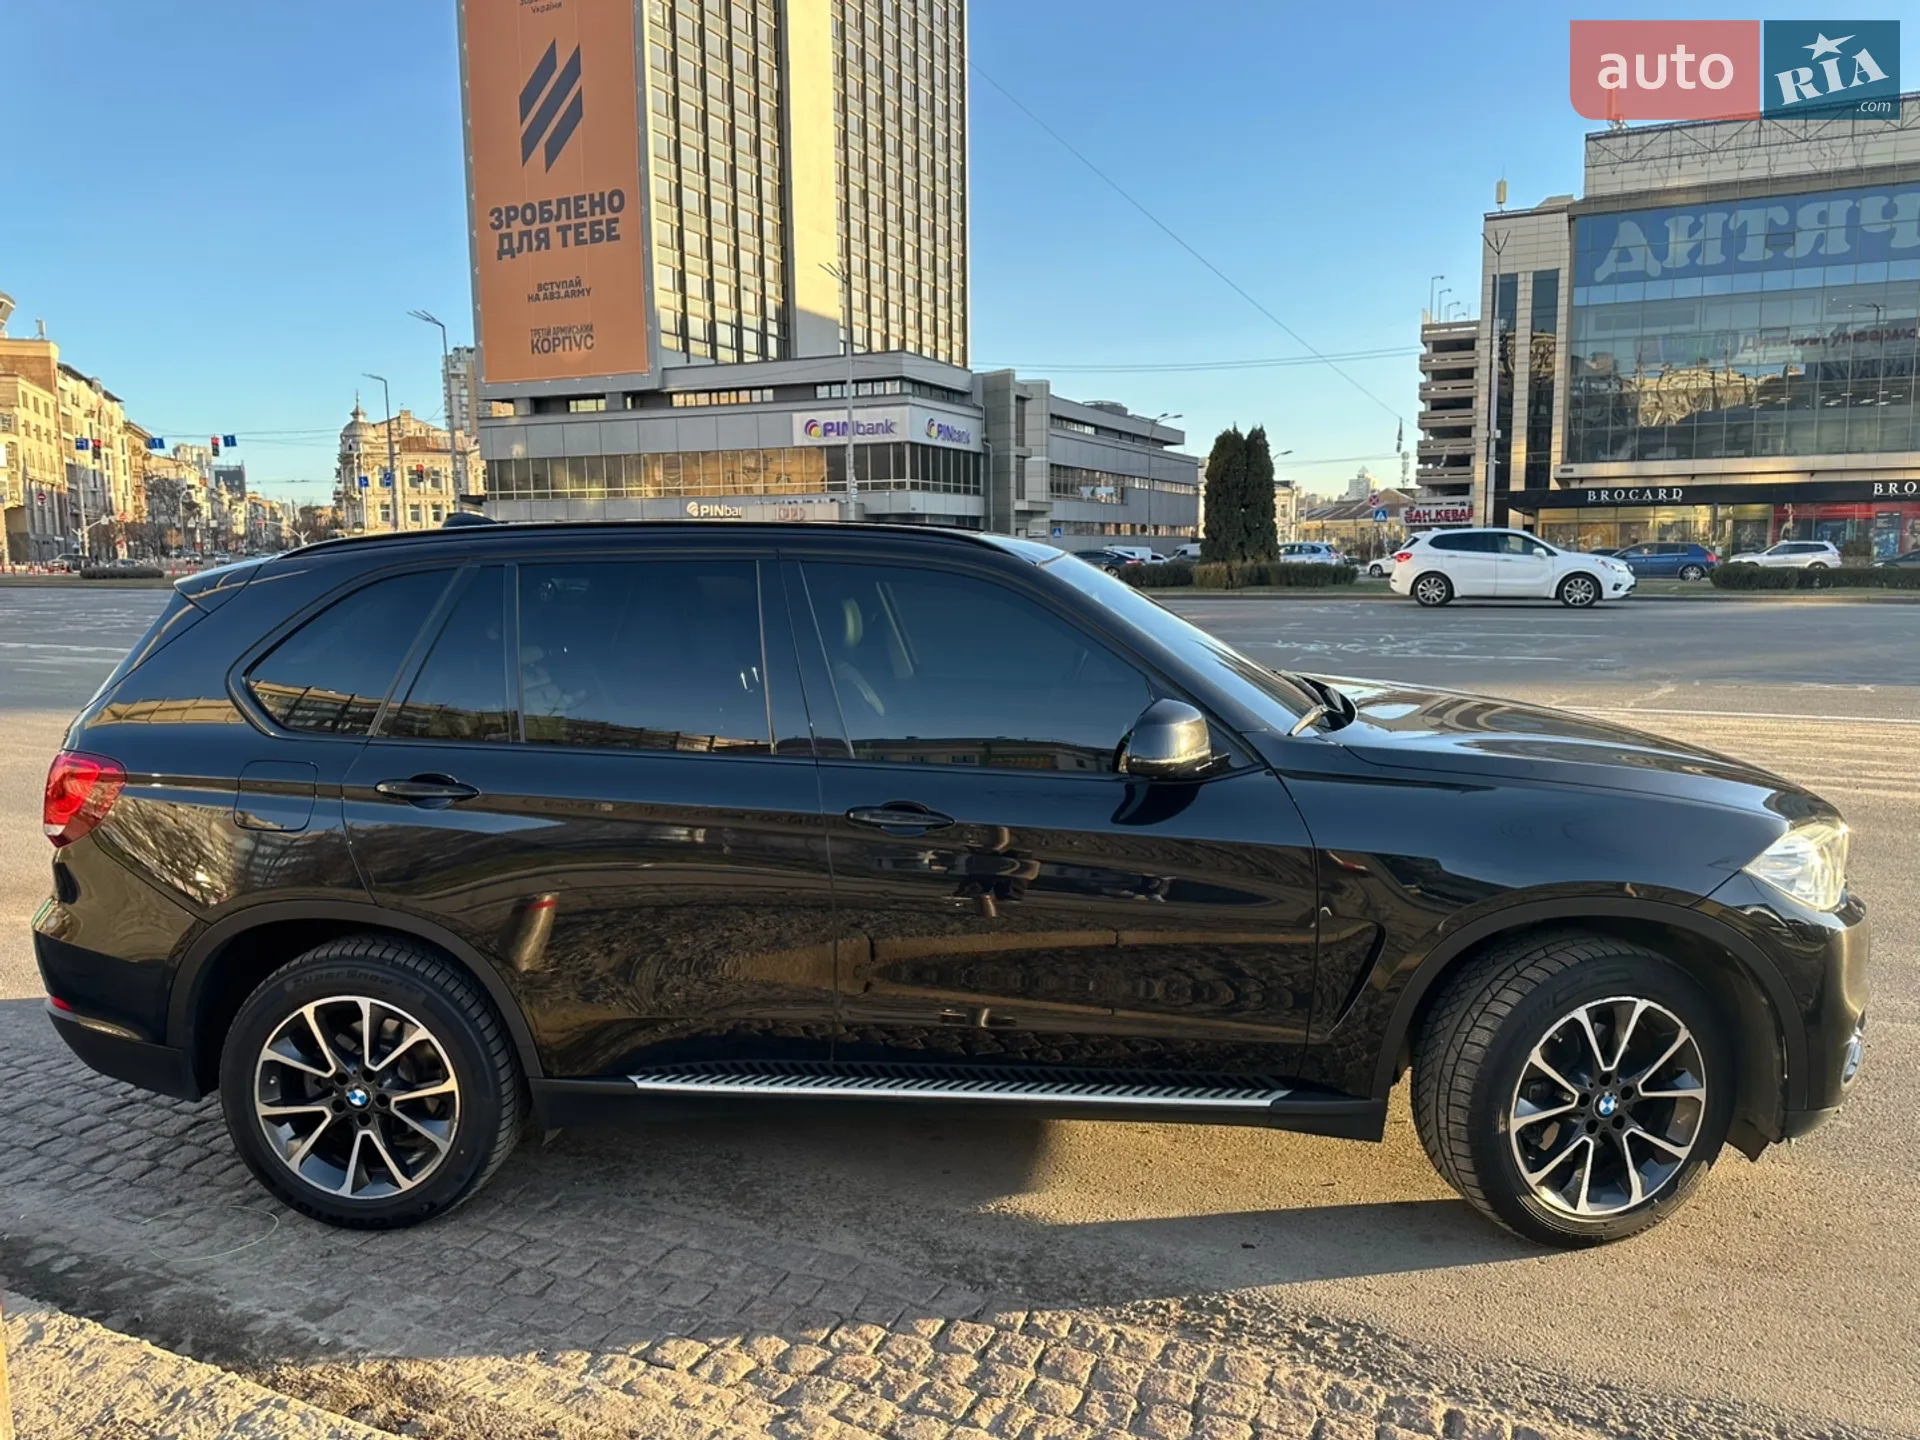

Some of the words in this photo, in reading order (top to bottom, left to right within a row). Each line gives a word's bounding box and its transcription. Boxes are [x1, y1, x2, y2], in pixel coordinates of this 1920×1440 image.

[489, 188, 626, 231] ЗРОБЛЕНО
[497, 227, 551, 261] ДЛЯ
[556, 217, 621, 248] ТЕБЕ
[537, 276, 582, 292] ВСТУПАЙ
[527, 293, 541, 303] НА
[531, 334, 594, 355] КОРПУС
[822, 418, 898, 437] PINbank
[934, 422, 971, 445] PINbank
[1587, 487, 1683, 501] BROCARD
[1873, 481, 1917, 495] BRO
[1435, 507, 1474, 518] KEBAB
